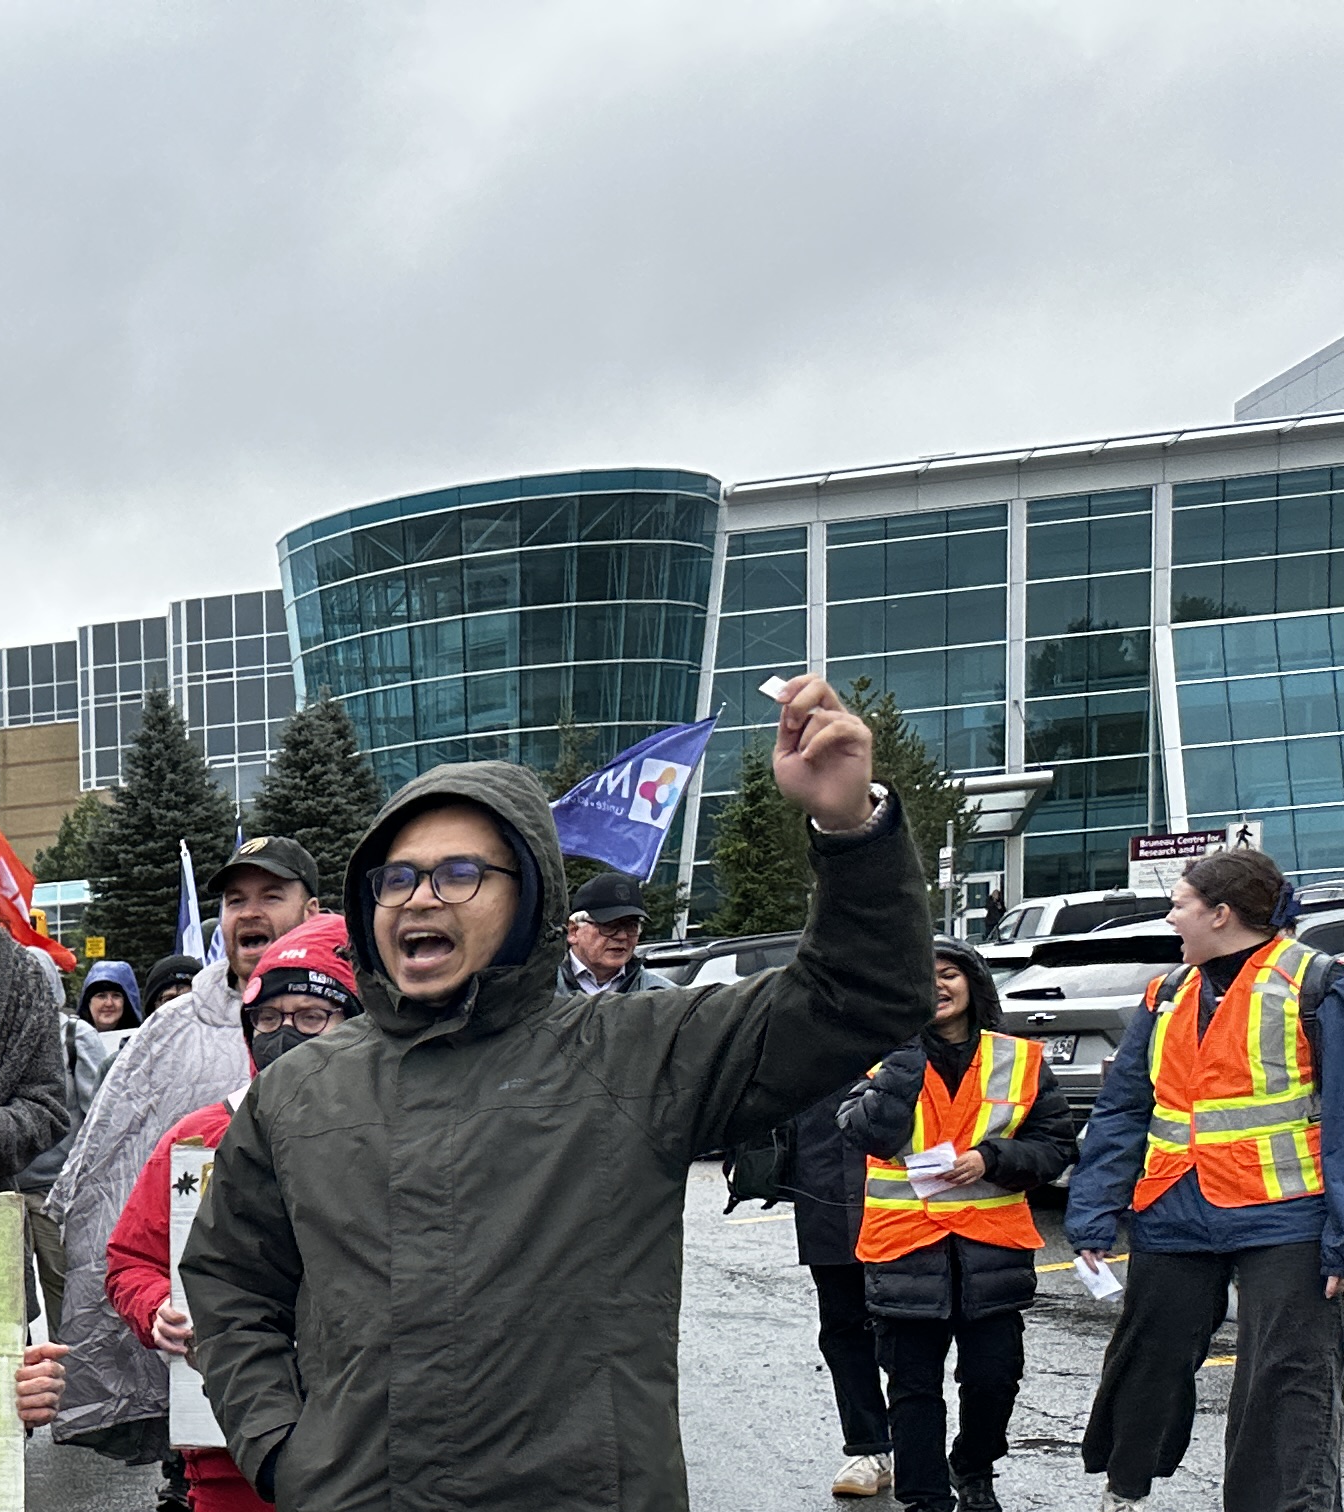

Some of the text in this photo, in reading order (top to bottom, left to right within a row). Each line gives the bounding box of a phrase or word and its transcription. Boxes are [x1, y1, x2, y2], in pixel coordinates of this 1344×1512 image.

[1177, 836, 1206, 845] Centre
[1138, 847, 1176, 857] Research
[1178, 845, 1195, 854] and
